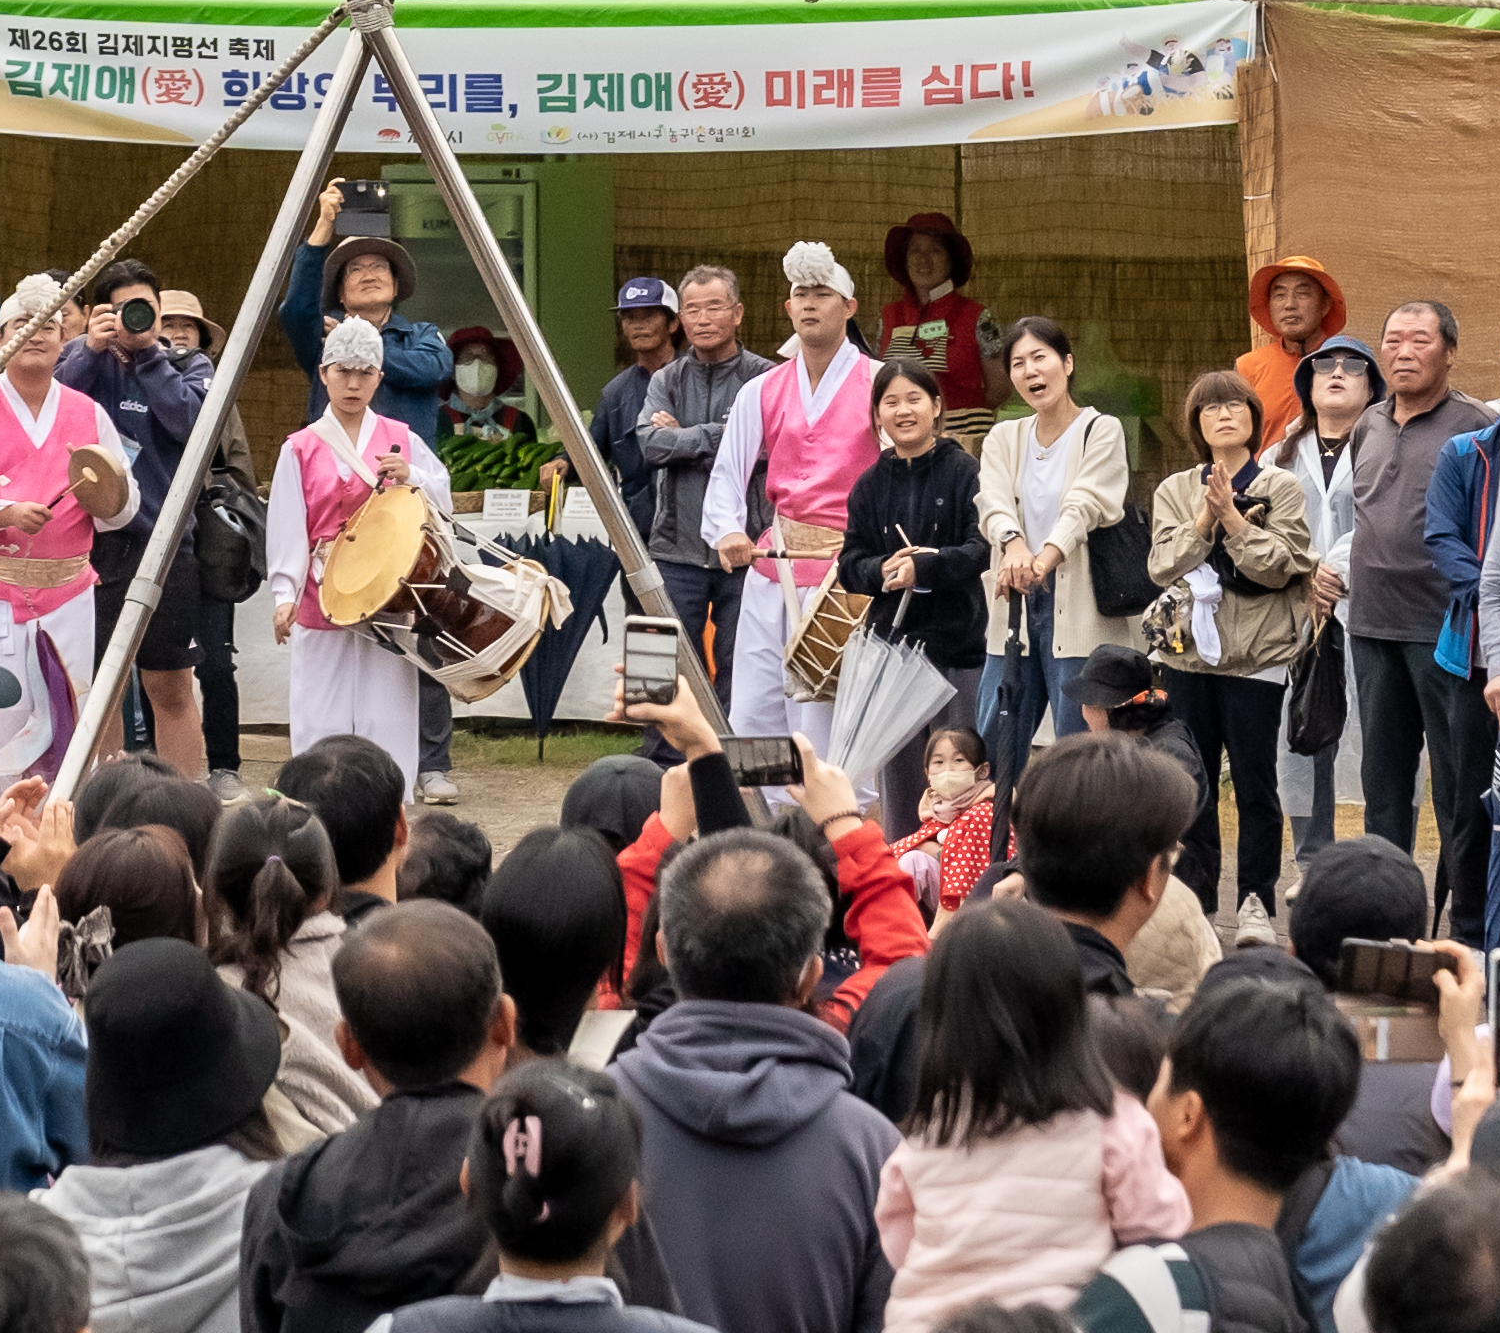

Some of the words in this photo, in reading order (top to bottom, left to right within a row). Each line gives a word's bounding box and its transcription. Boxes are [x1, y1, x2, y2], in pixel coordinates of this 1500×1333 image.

[7, 27, 87, 54] 제26회
[97, 32, 219, 60] 김제지평선
[228, 37, 275, 61] 축제
[4, 59, 205, 107] 김제애(愛)
[536, 70, 746, 113] 김제애(愛)
[765, 66, 902, 110] 미래를
[921, 60, 1036, 107] 심다!
